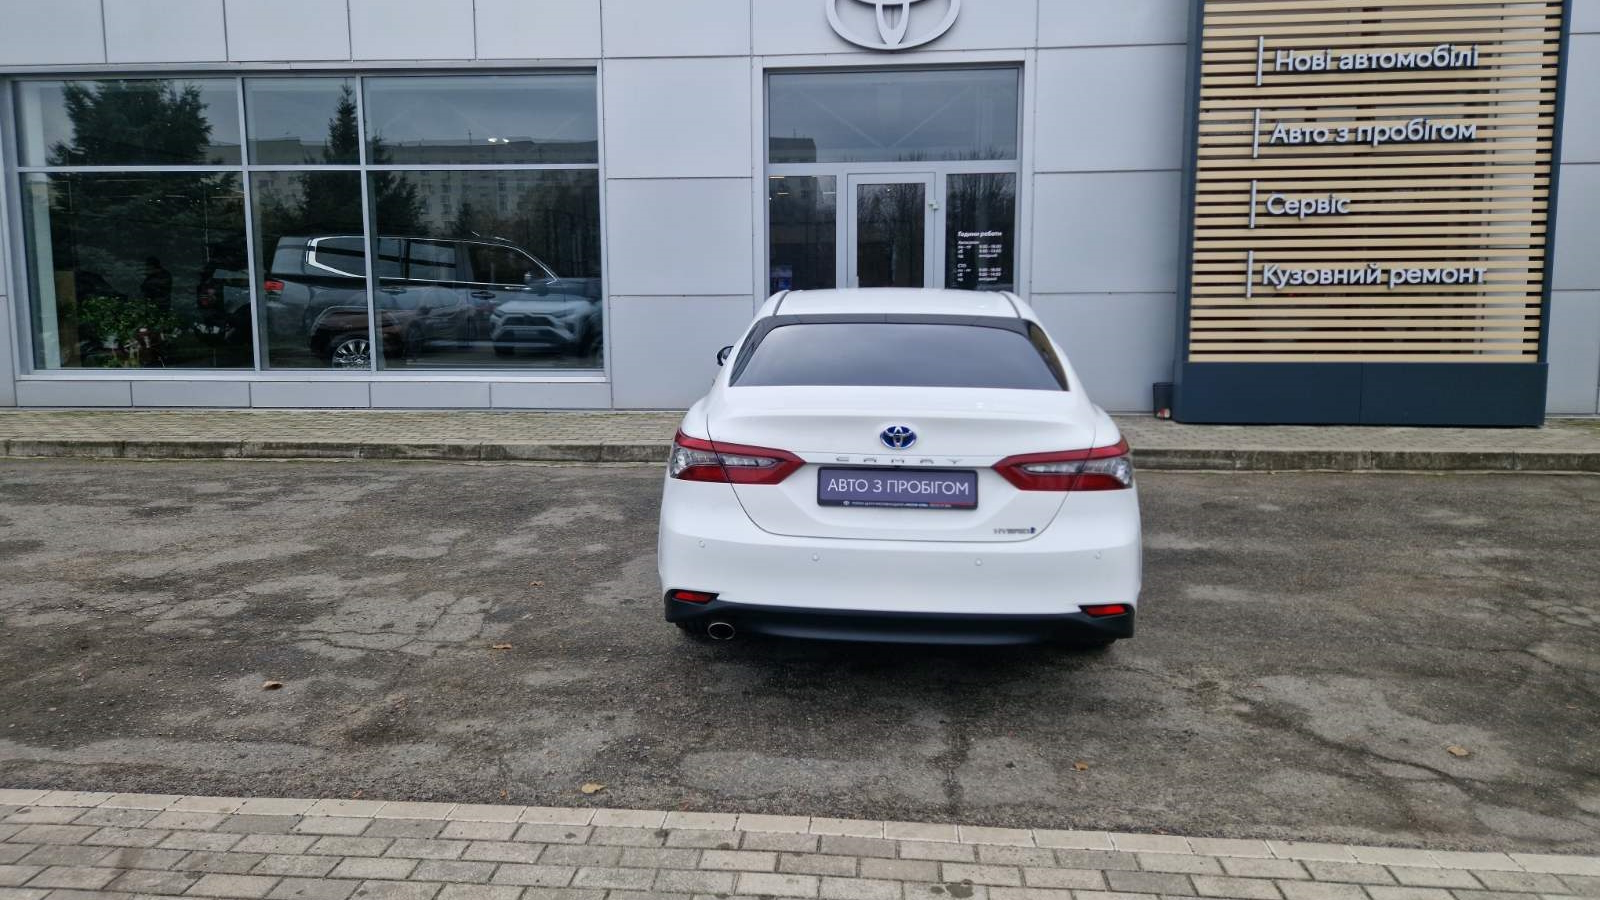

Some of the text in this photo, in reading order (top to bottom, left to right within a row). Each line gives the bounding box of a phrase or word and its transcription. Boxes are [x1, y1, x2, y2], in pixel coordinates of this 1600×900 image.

[1275, 45, 1479, 71] Нові автомобілі
[1270, 118, 1477, 147] Авто з пробігом
[1267, 194, 1350, 219] Сервіс
[1263, 263, 1487, 290] Кузовний ремонт
[827, 478, 969, 495] АВТО З ПРОБІГОМ
